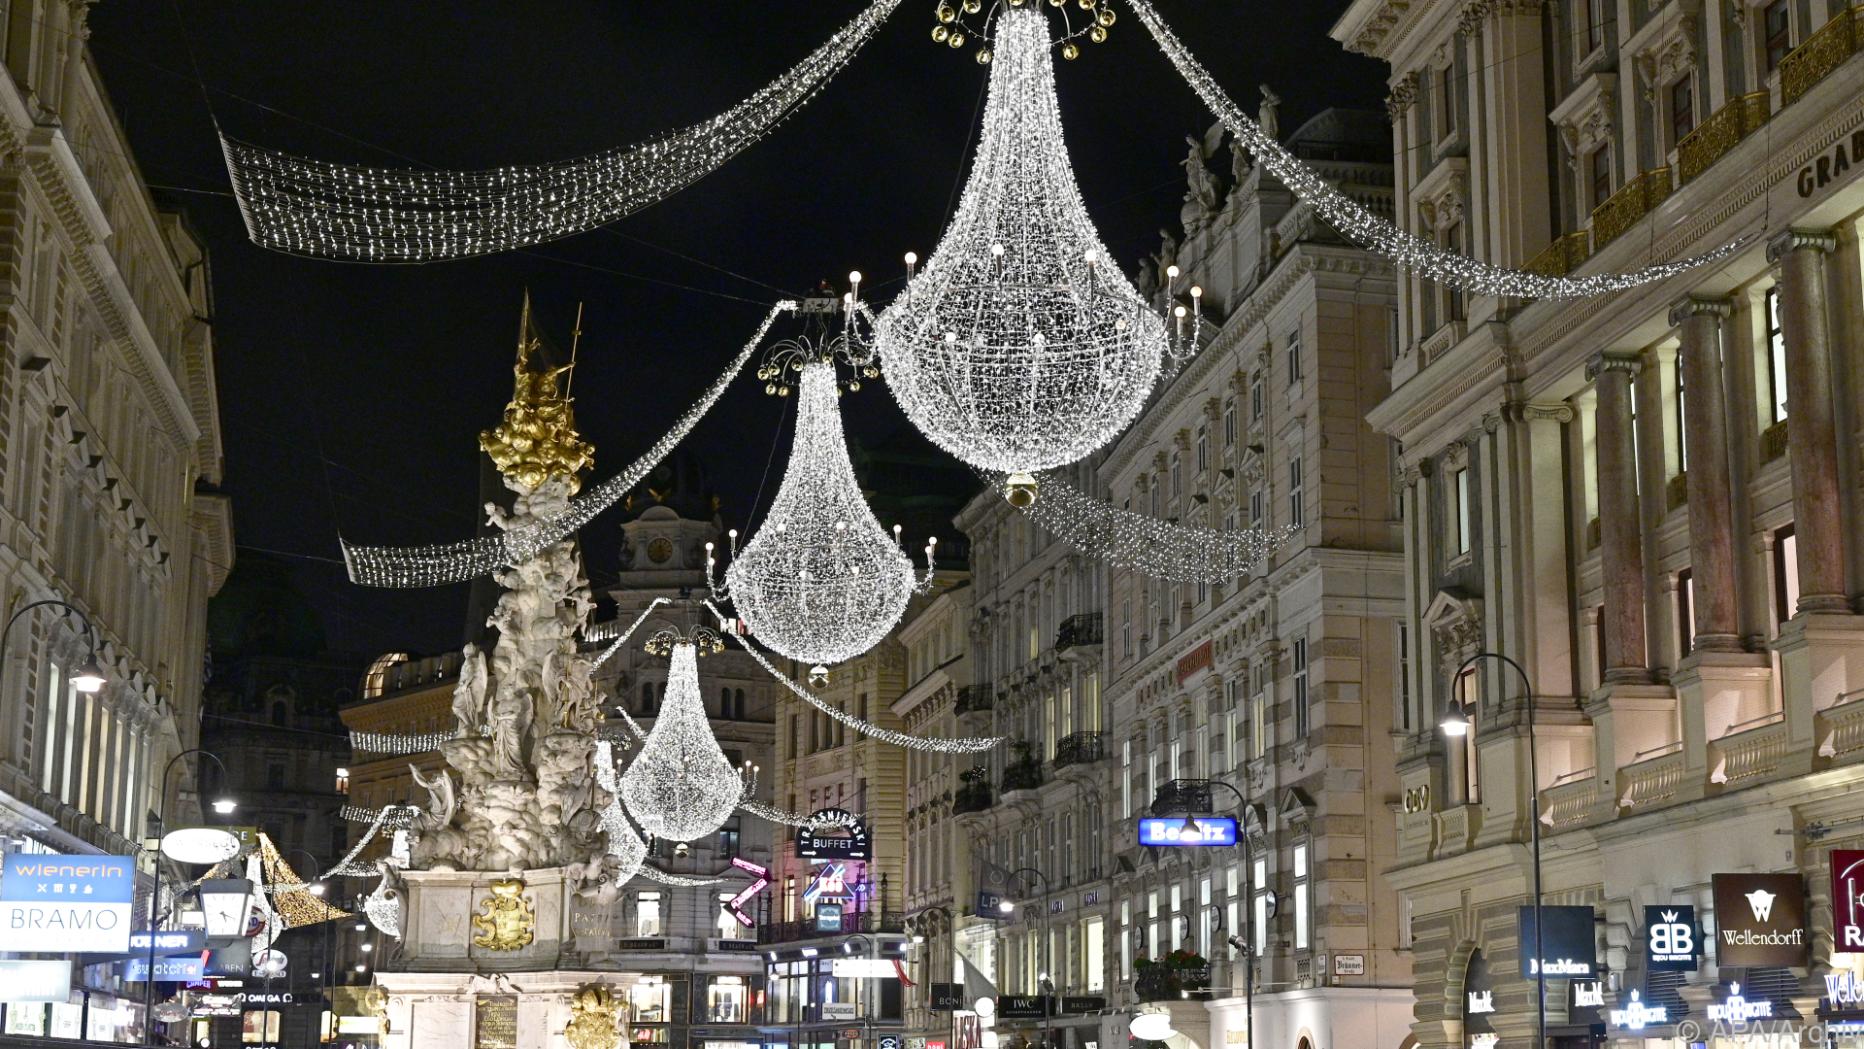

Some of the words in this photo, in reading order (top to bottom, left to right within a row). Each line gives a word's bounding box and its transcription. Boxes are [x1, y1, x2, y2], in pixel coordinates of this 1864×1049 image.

[813, 839, 852, 849] BUFFET
[16, 864, 122, 878] wienerin
[11, 908, 118, 930] BRAMO
[1722, 929, 1803, 946] Wellendorff
[1844, 925, 1864, 946] R
[248, 994, 280, 1002] OMGA
[1013, 999, 1034, 1009] IWC
